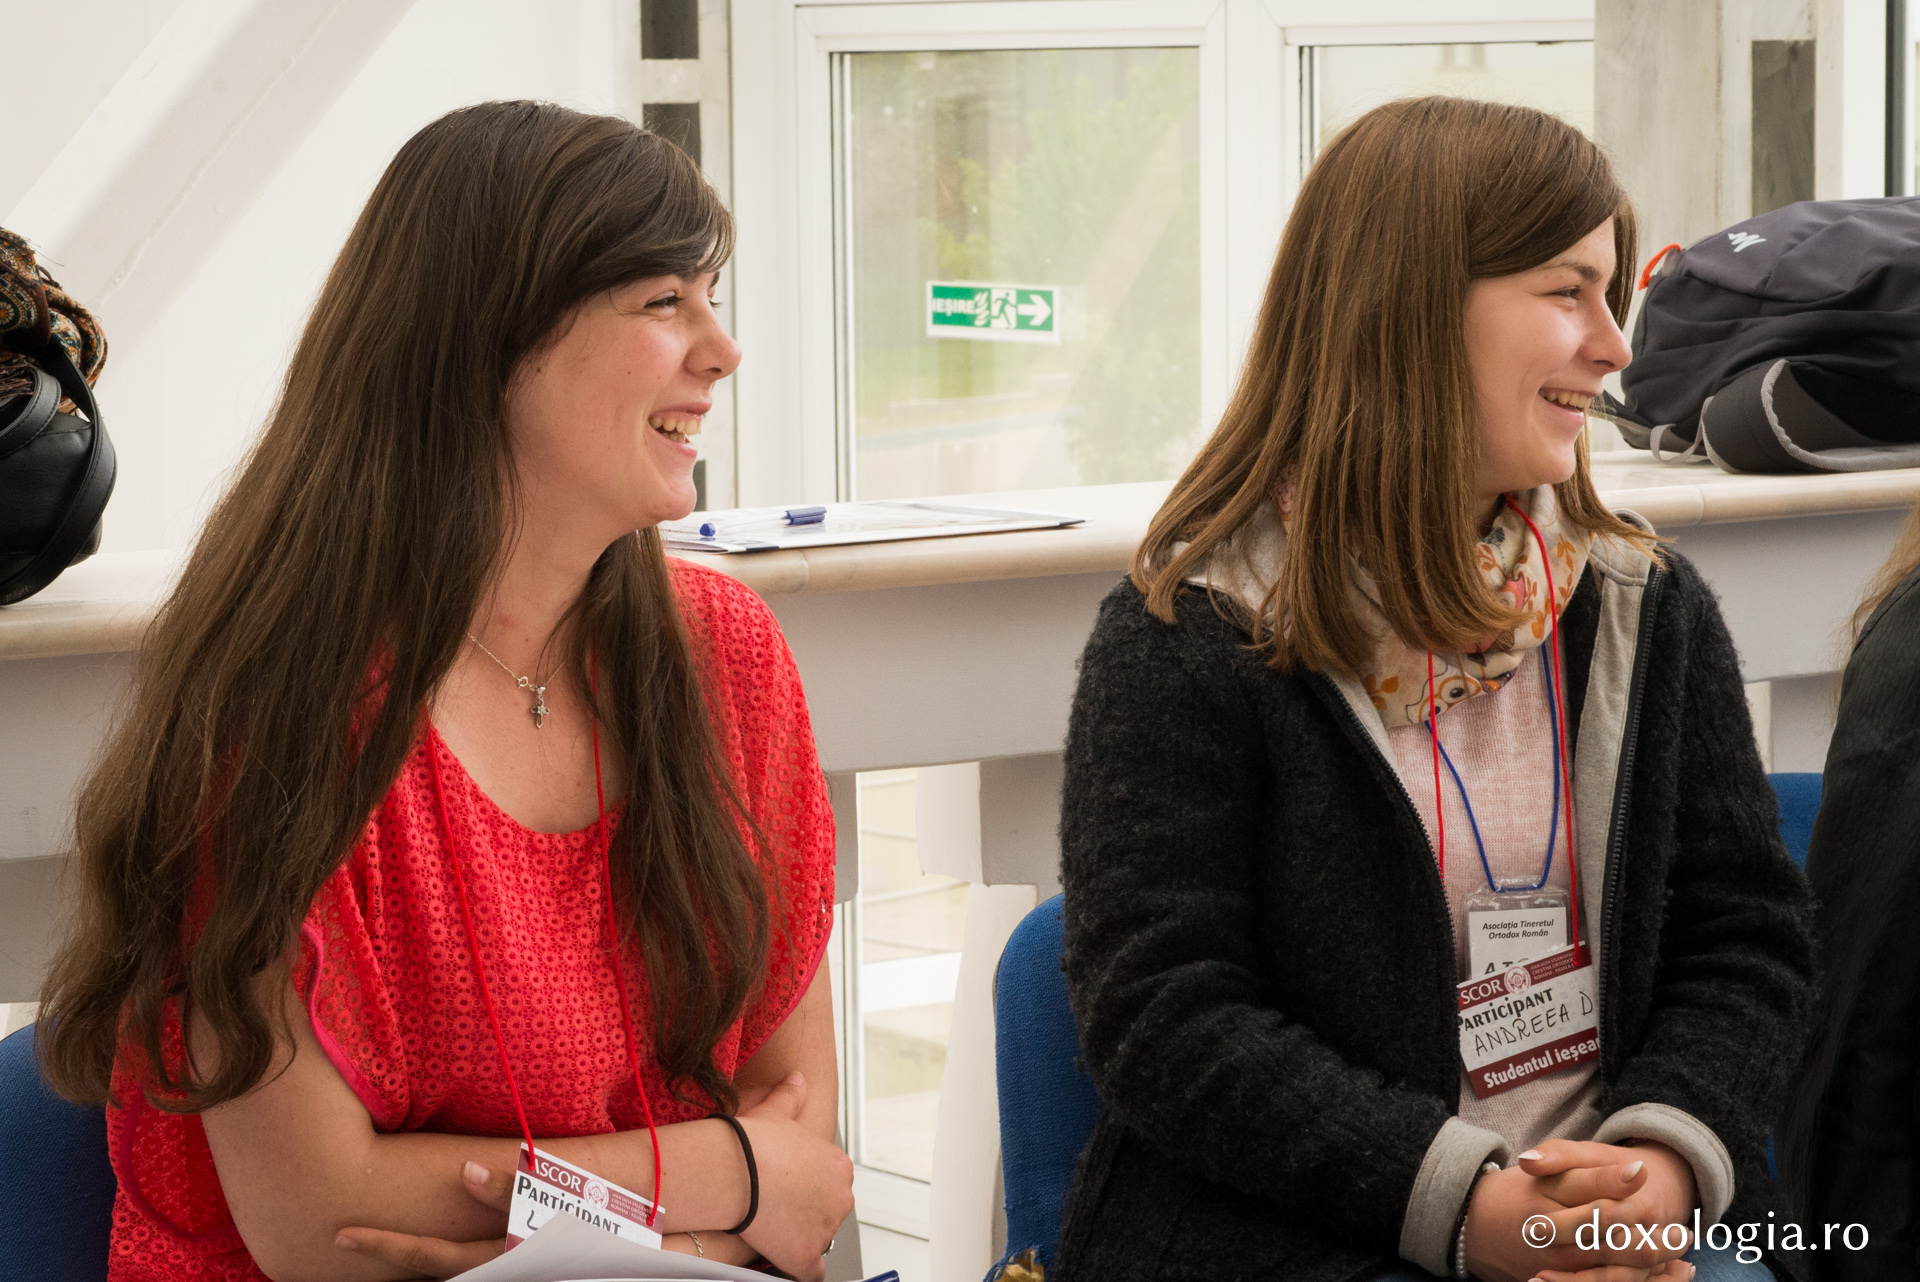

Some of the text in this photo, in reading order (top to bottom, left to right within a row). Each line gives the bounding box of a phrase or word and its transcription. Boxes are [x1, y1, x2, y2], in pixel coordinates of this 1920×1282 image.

[1482, 919, 1554, 931] Asociația Tineretul
[1488, 929, 1549, 940] Ortodox Român
[1458, 979, 1503, 1005] SCOR
[1475, 1003, 1570, 1056] ANDREEA
[1483, 1050, 1554, 1088] Studentul
